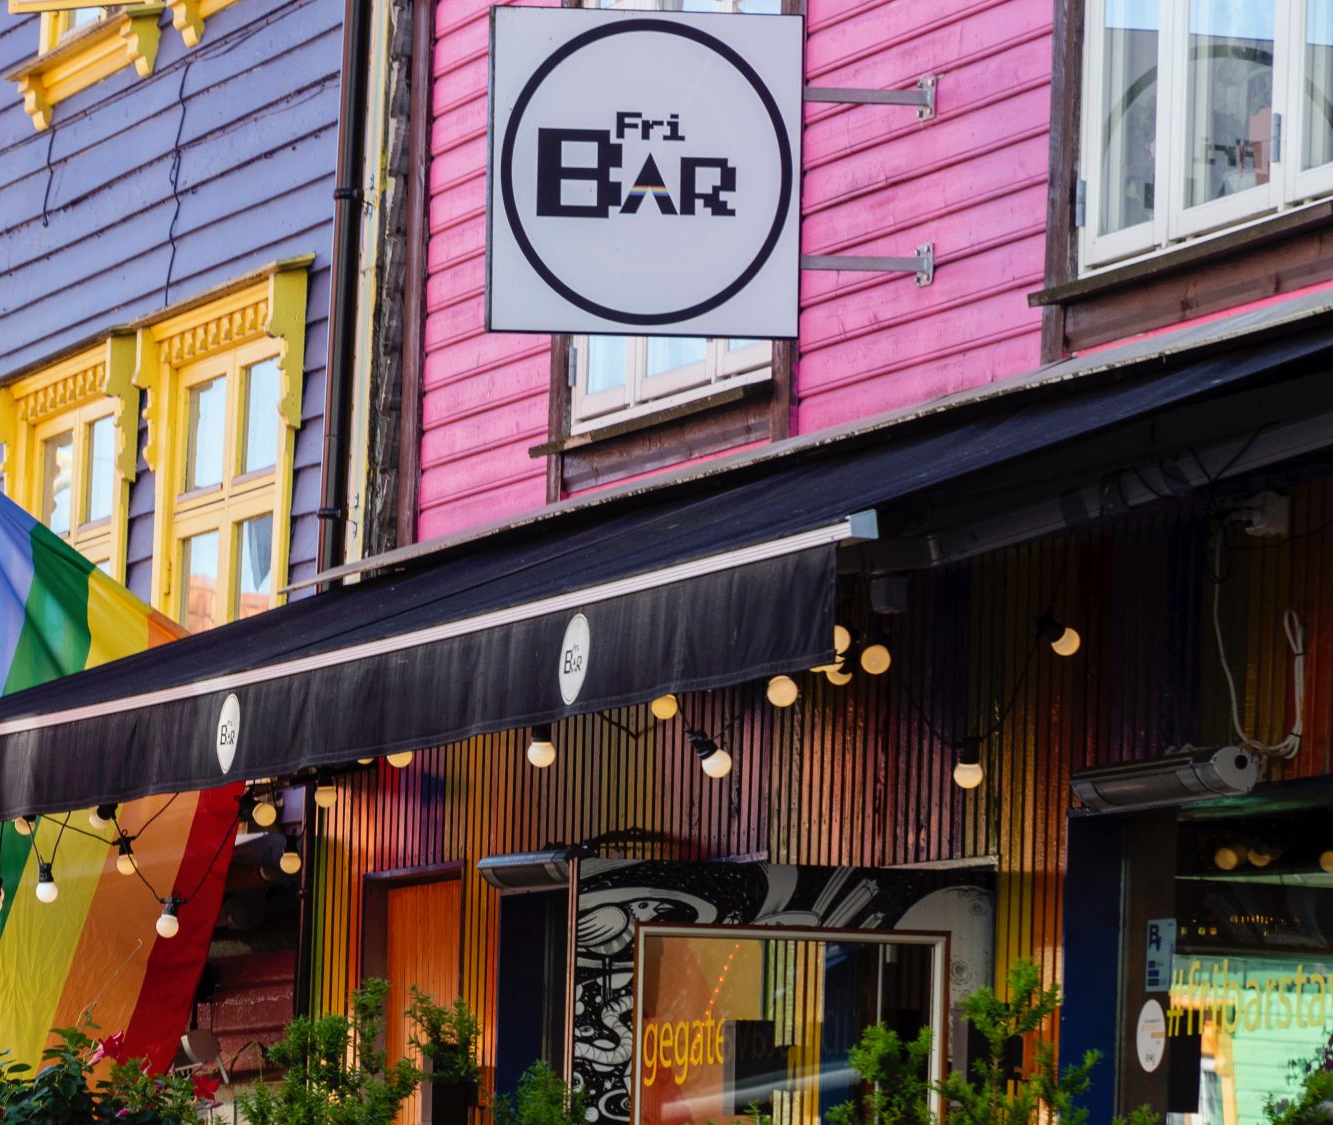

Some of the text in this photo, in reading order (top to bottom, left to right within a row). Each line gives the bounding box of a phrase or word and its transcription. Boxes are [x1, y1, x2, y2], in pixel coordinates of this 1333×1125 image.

[616, 111, 685, 142] Fri
[536, 127, 737, 219] BAR
[1166, 958, 1333, 1037] #fribarsta
